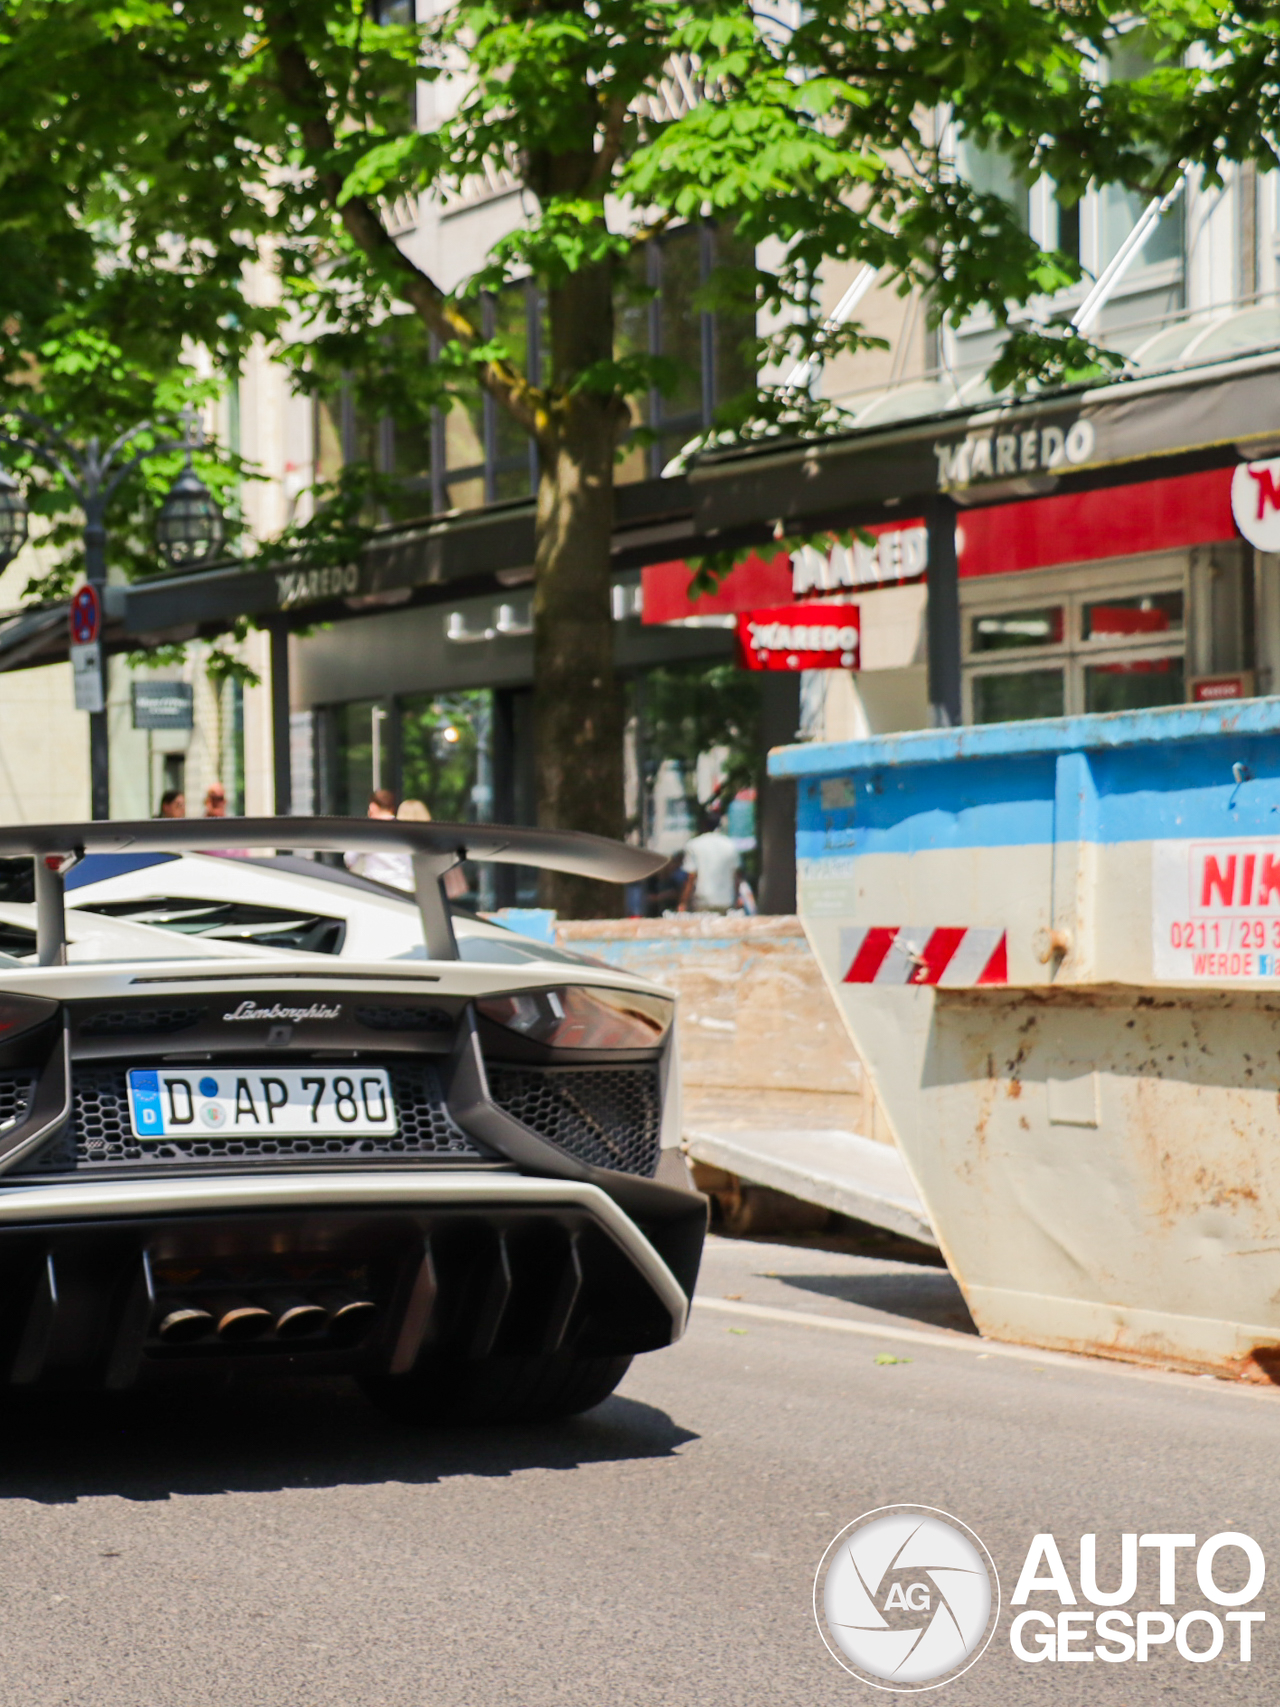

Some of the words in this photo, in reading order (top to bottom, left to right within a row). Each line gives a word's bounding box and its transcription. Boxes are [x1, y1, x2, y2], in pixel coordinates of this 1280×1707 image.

[934, 419, 1095, 485] MAREDO
[789, 526, 965, 594] MARED
[747, 621, 858, 651] MAREDO
[1192, 953, 1252, 976] WERDE
[223, 1000, 341, 1022] Lamborghini
[164, 1078, 195, 1125] D
[235, 1077, 289, 1124] AP
[301, 1076, 388, 1123] 780
[142, 1108, 157, 1124] D
